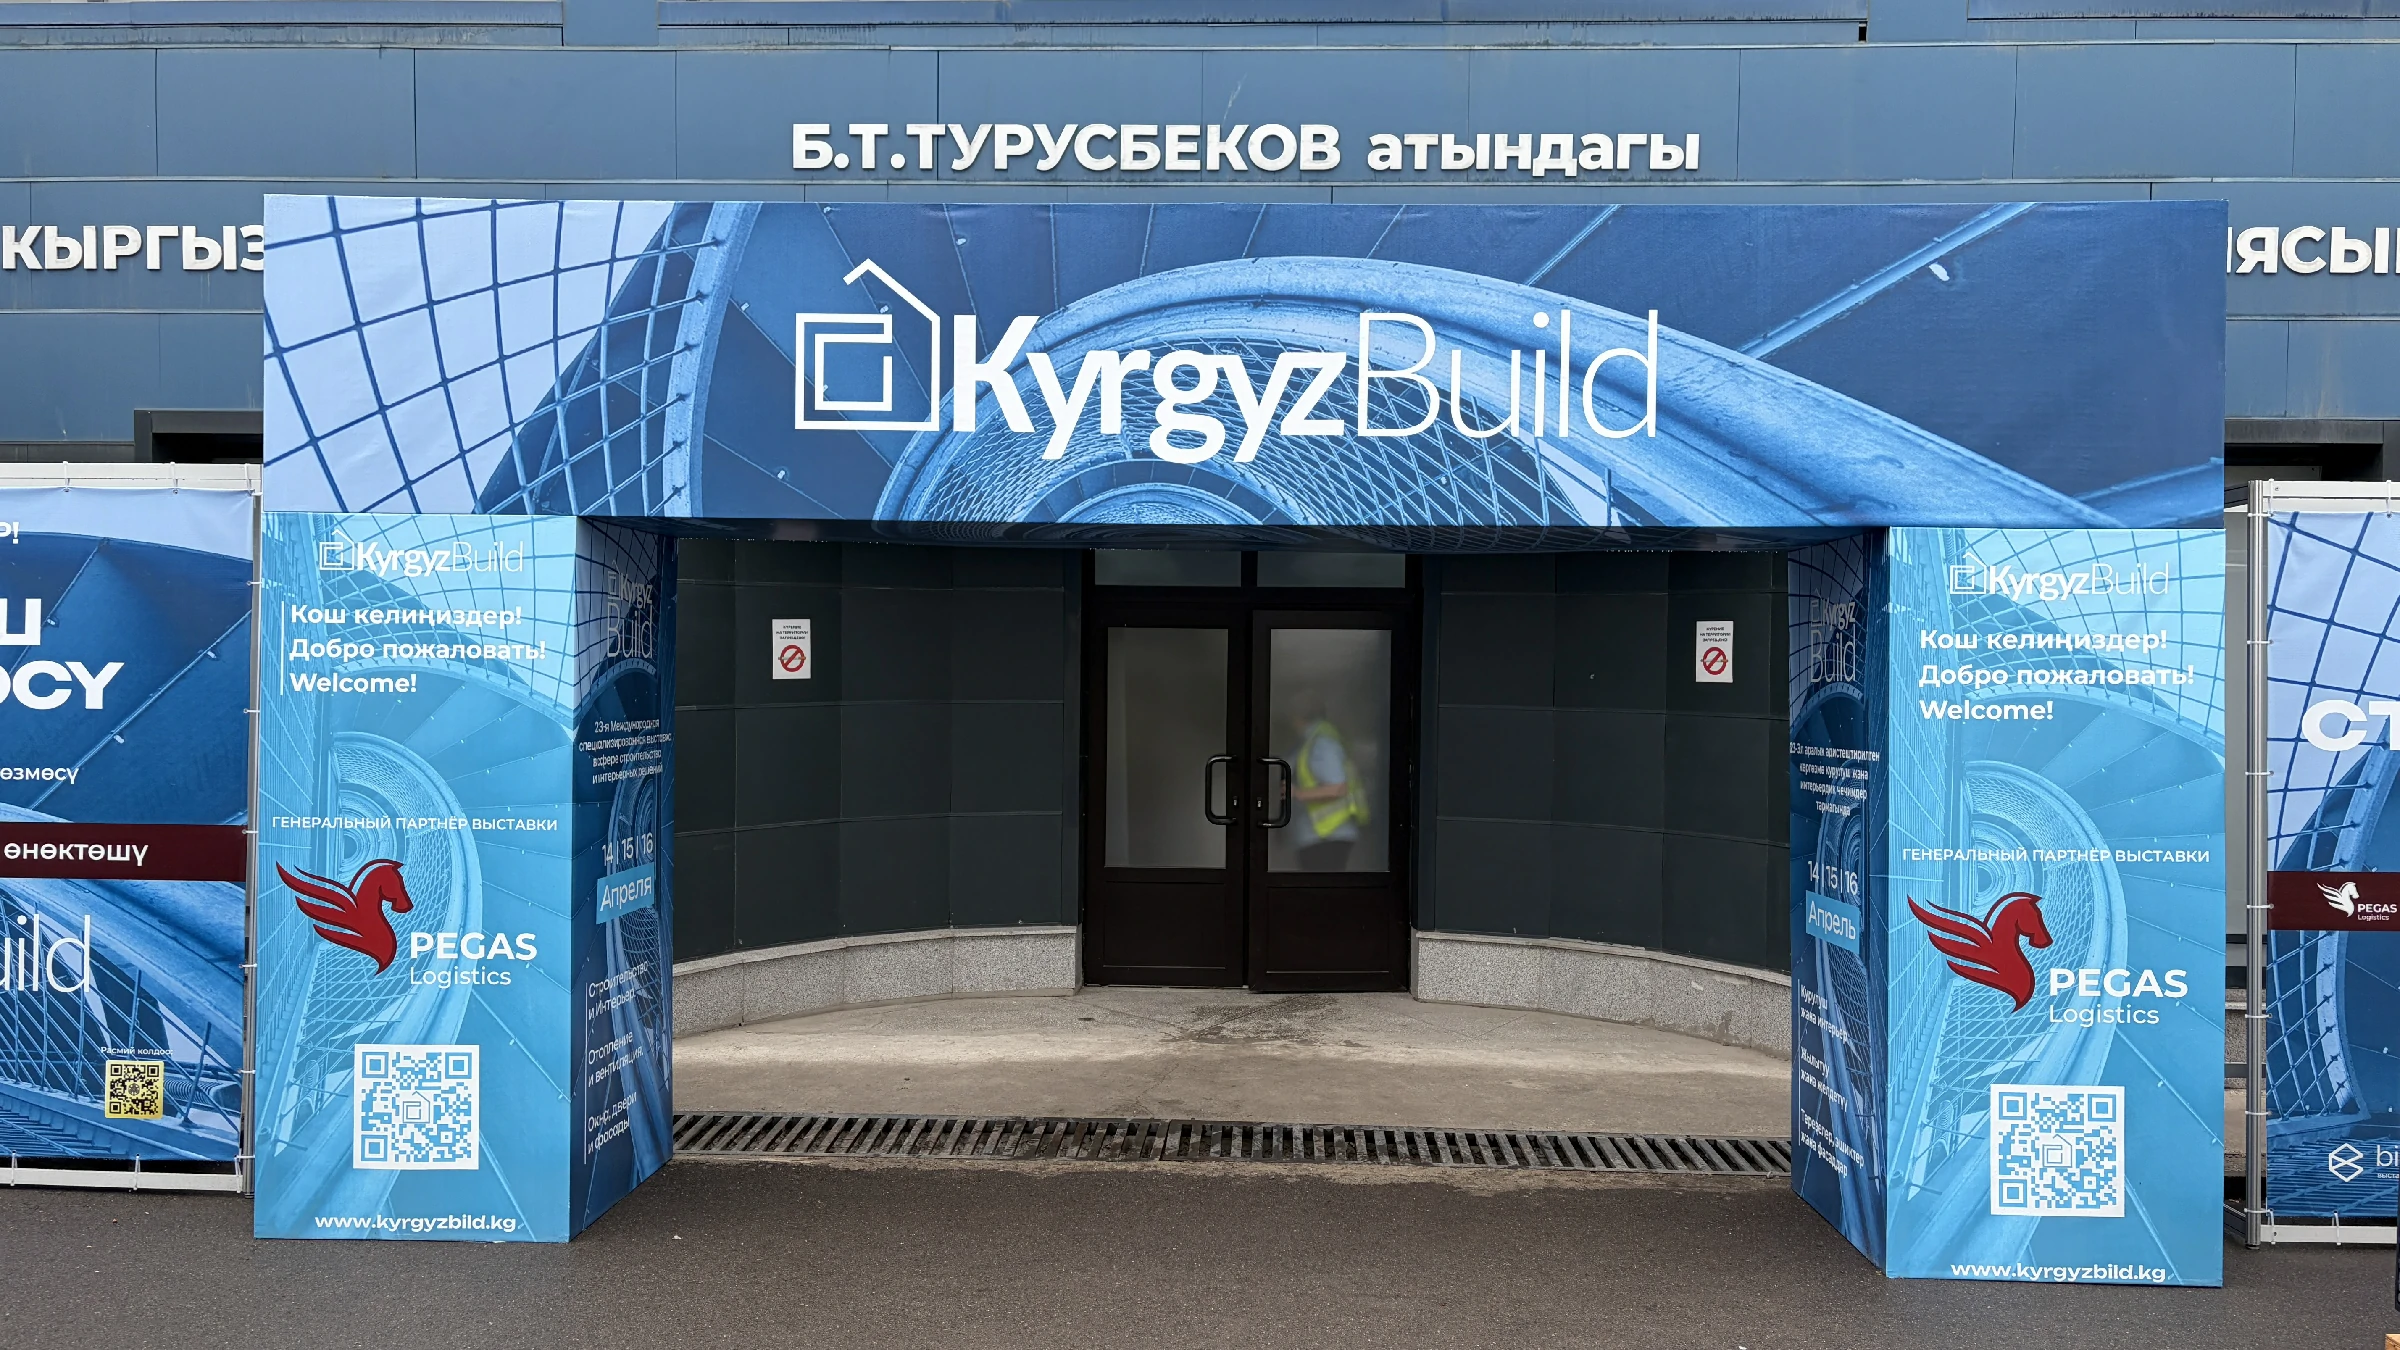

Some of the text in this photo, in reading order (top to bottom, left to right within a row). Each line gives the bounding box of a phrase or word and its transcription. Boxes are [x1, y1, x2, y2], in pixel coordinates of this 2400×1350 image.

[791, 122, 1701, 177] Б.Т.ТУРУСБЕКОВ атындагы
[2227, 226, 2400, 275] ЯСЫ
[954, 309, 1659, 465] KyrgyzBuild
[356, 540, 524, 577] KyrgyzBuild
[1989, 562, 2170, 602] KyrgyzBuild
[290, 604, 523, 630] Кош келиңиздер!
[606, 602, 653, 659] Build
[1920, 629, 2168, 654] Кош келиңиздер!
[289, 638, 547, 663] Добро пожаловать!
[1810, 624, 1856, 683] Build
[289, 672, 417, 693] Welcome!
[1918, 664, 2194, 688] Добро пожаловать!
[1918, 700, 2054, 721] Welcome!
[272, 814, 558, 832] ГЕНЕРАЛЬНЫЙ ПАРТНЁР ВЫСТАВКИ
[4, 842, 149, 867] өнөктөшү
[602, 832, 654, 866] 14 15 16
[1902, 846, 2210, 863] ГЕНЕРАЛЬНЫЙ ПАРТНЁР ВЫСТАВКИ
[1807, 860, 1858, 896] 14 15 16
[599, 876, 652, 912] Апреля
[1808, 900, 1856, 940] Апрель
[2357, 903, 2398, 913] PEGAS
[2357, 914, 2390, 922] Logistics
[410, 932, 538, 961] PEGAS
[410, 966, 512, 989] Logistics
[2049, 968, 2189, 998] PEGAS
[2049, 1004, 2160, 1028] Logistics
[100, 1045, 136, 1055] Расмий
[588, 1031, 633, 1065] Отопление
[314, 1213, 517, 1233] www.kyrgyzbild.kg
[1950, 1261, 2167, 1284] www.kyrgyzbild.kg
